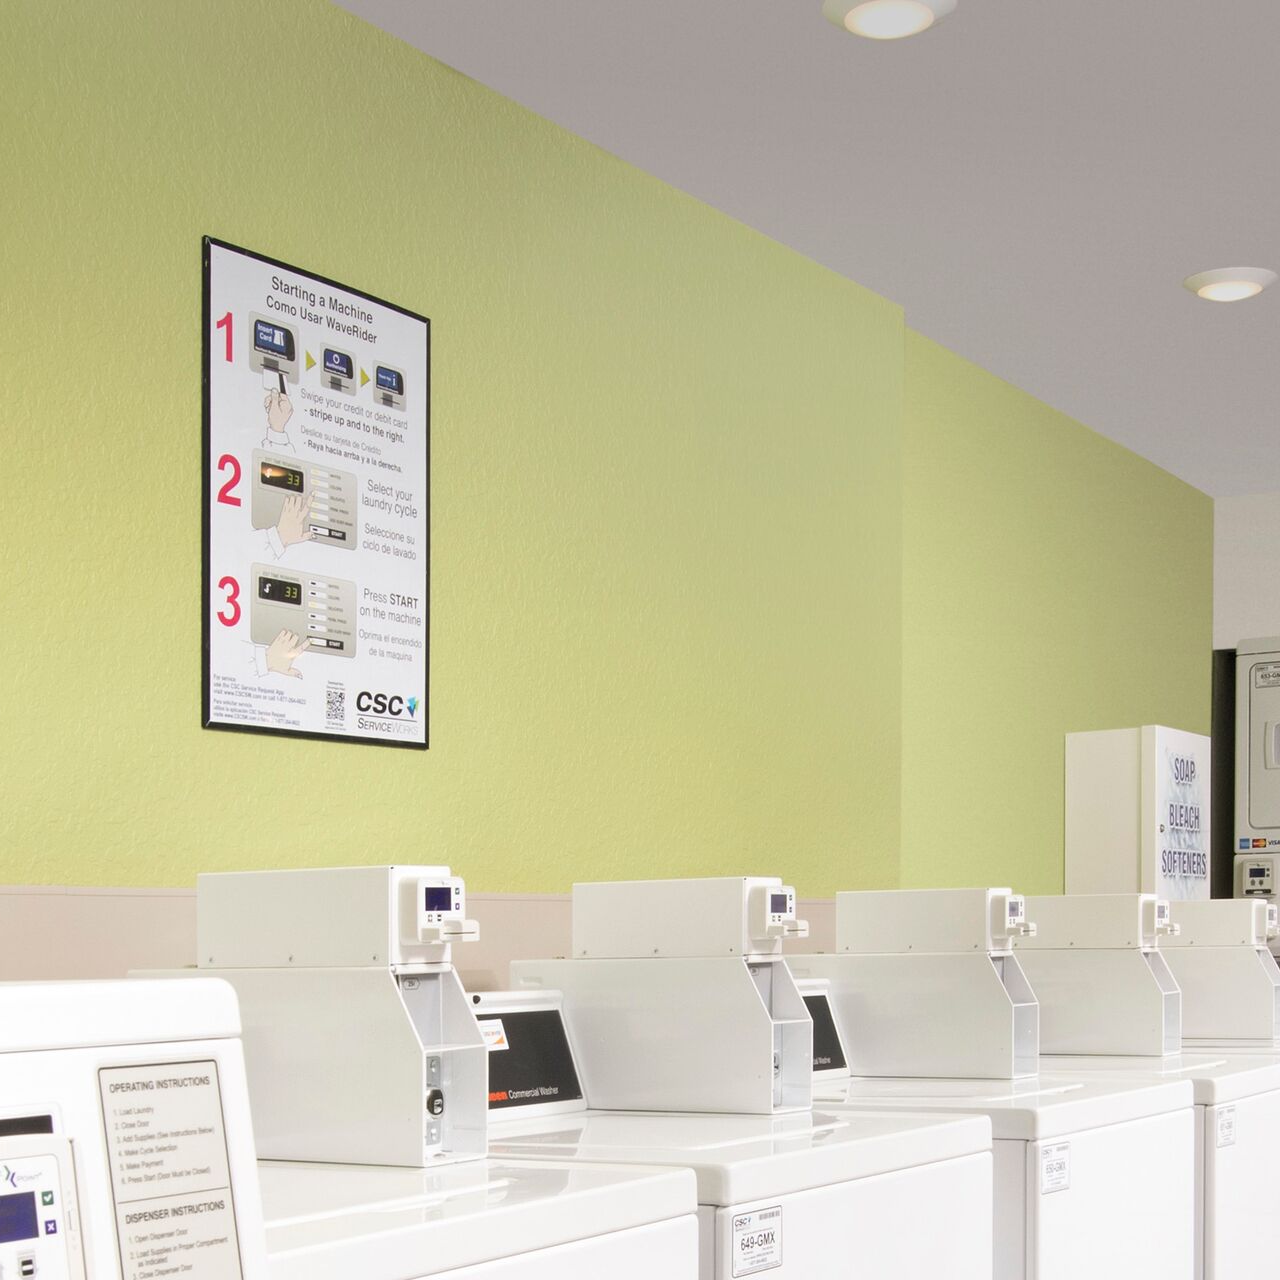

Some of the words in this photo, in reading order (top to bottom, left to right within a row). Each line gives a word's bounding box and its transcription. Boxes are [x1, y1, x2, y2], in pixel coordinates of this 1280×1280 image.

[272, 276, 316, 307] Starting
[319, 296, 325, 307] a
[329, 297, 373, 324] Machine
[266, 295, 297, 316] Como
[300, 307, 323, 325] Usar
[326, 316, 377, 344] WaveRider
[216, 312, 233, 362] 1
[301, 388, 323, 404] Swipe
[326, 398, 342, 409] your
[343, 403, 364, 416] credit
[365, 410, 373, 418] or
[375, 412, 391, 424] debit
[393, 418, 408, 430] card
[309, 408, 332, 422] stripe
[335, 415, 344, 426] up
[347, 418, 360, 430] and
[363, 423, 370, 432] to
[373, 426, 384, 437] the
[308, 440, 324, 452] Raya
[325, 445, 342, 456] hacia
[217, 453, 242, 508] 2
[367, 479, 393, 497] Select
[396, 490, 412, 502] your
[362, 493, 392, 514] laundry
[395, 503, 417, 518] cycle
[365, 523, 404, 542] Seleccione
[407, 535, 415, 544] su
[381, 543, 391, 554] de
[393, 546, 416, 560] lavado
[217, 576, 241, 627] 3
[285, 586, 297, 598] 33
[364, 588, 387, 603] Press
[390, 593, 418, 609] START
[360, 607, 370, 616] on
[373, 606, 385, 619] the
[388, 612, 421, 626] machine
[356, 691, 404, 716] CSC
[1174, 758, 1195, 782] SOAP
[1169, 804, 1199, 829] BLEACH
[1162, 850, 1206, 875] SOFTENERS
[109, 1081, 154, 1093] OPERATING
[156, 1076, 210, 1089] INSTRUCTIONS
[508, 1088, 539, 1099] Commercial
[540, 1086, 558, 1095] Washer
[125, 1208, 169, 1224] DISPENSER
[171, 1200, 225, 1217] INSTRUCTIONS
[741, 1231, 775, 1251] 649-GMX
